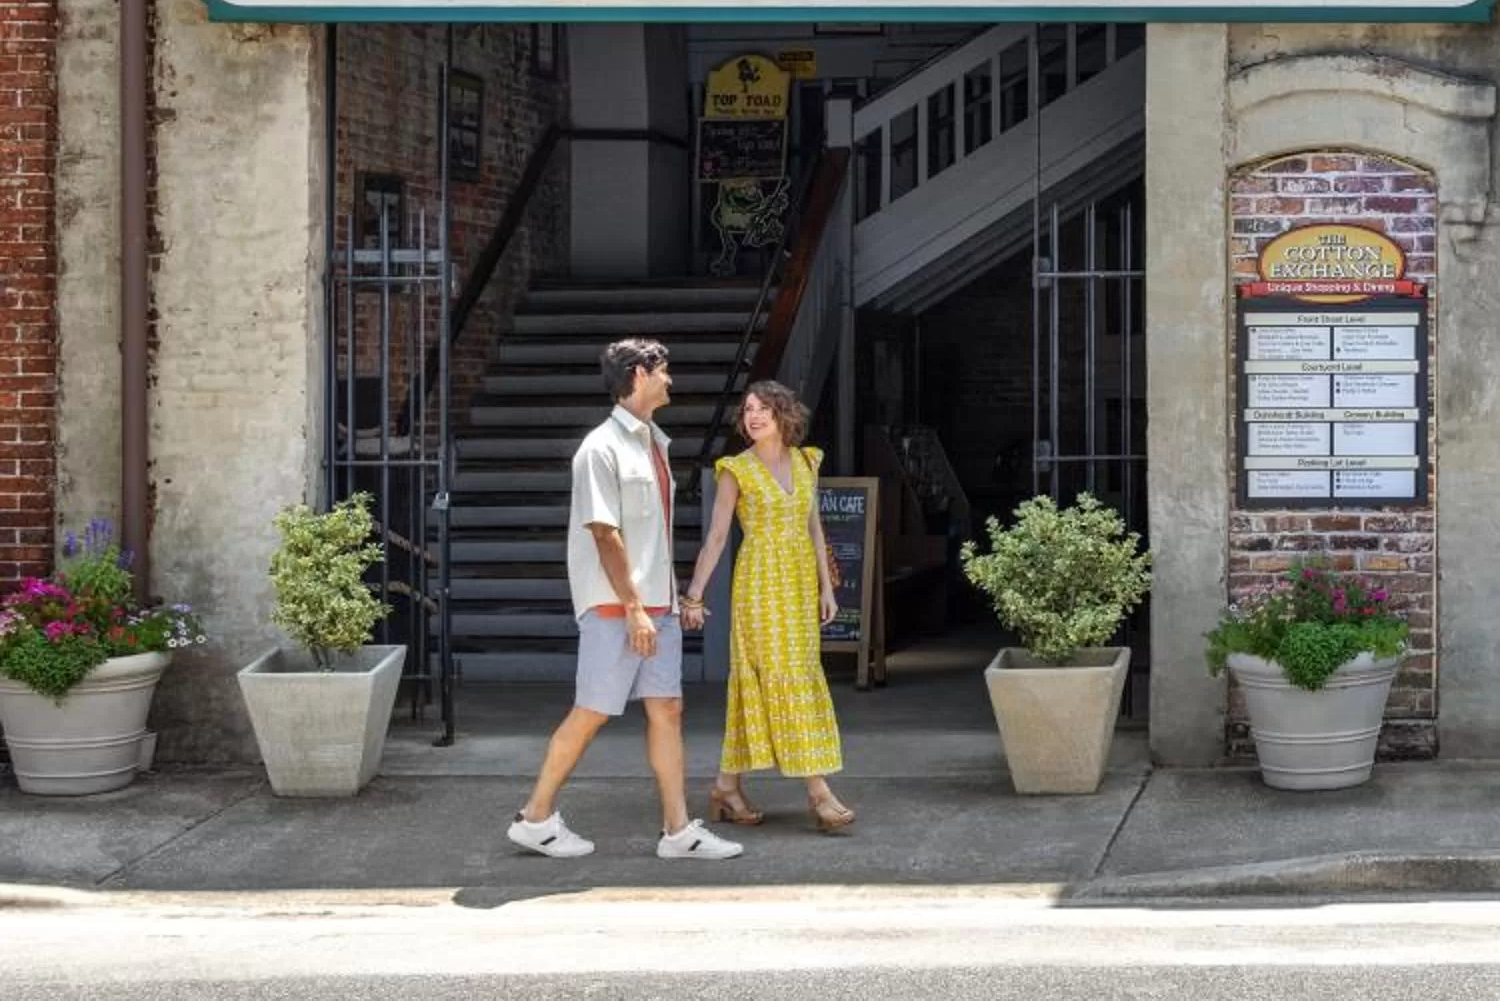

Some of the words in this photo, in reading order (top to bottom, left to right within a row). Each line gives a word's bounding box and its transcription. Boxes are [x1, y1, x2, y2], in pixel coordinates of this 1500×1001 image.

[712, 94, 737, 106] TOP
[746, 94, 782, 106] TOAD
[1318, 234, 1346, 245] THE
[1283, 246, 1382, 261] COTTON
[1270, 262, 1395, 278] EXCHANGE
[1267, 283, 1302, 293] Unique
[1305, 283, 1351, 293] Shopping
[1302, 363, 1340, 372] Courtyard
